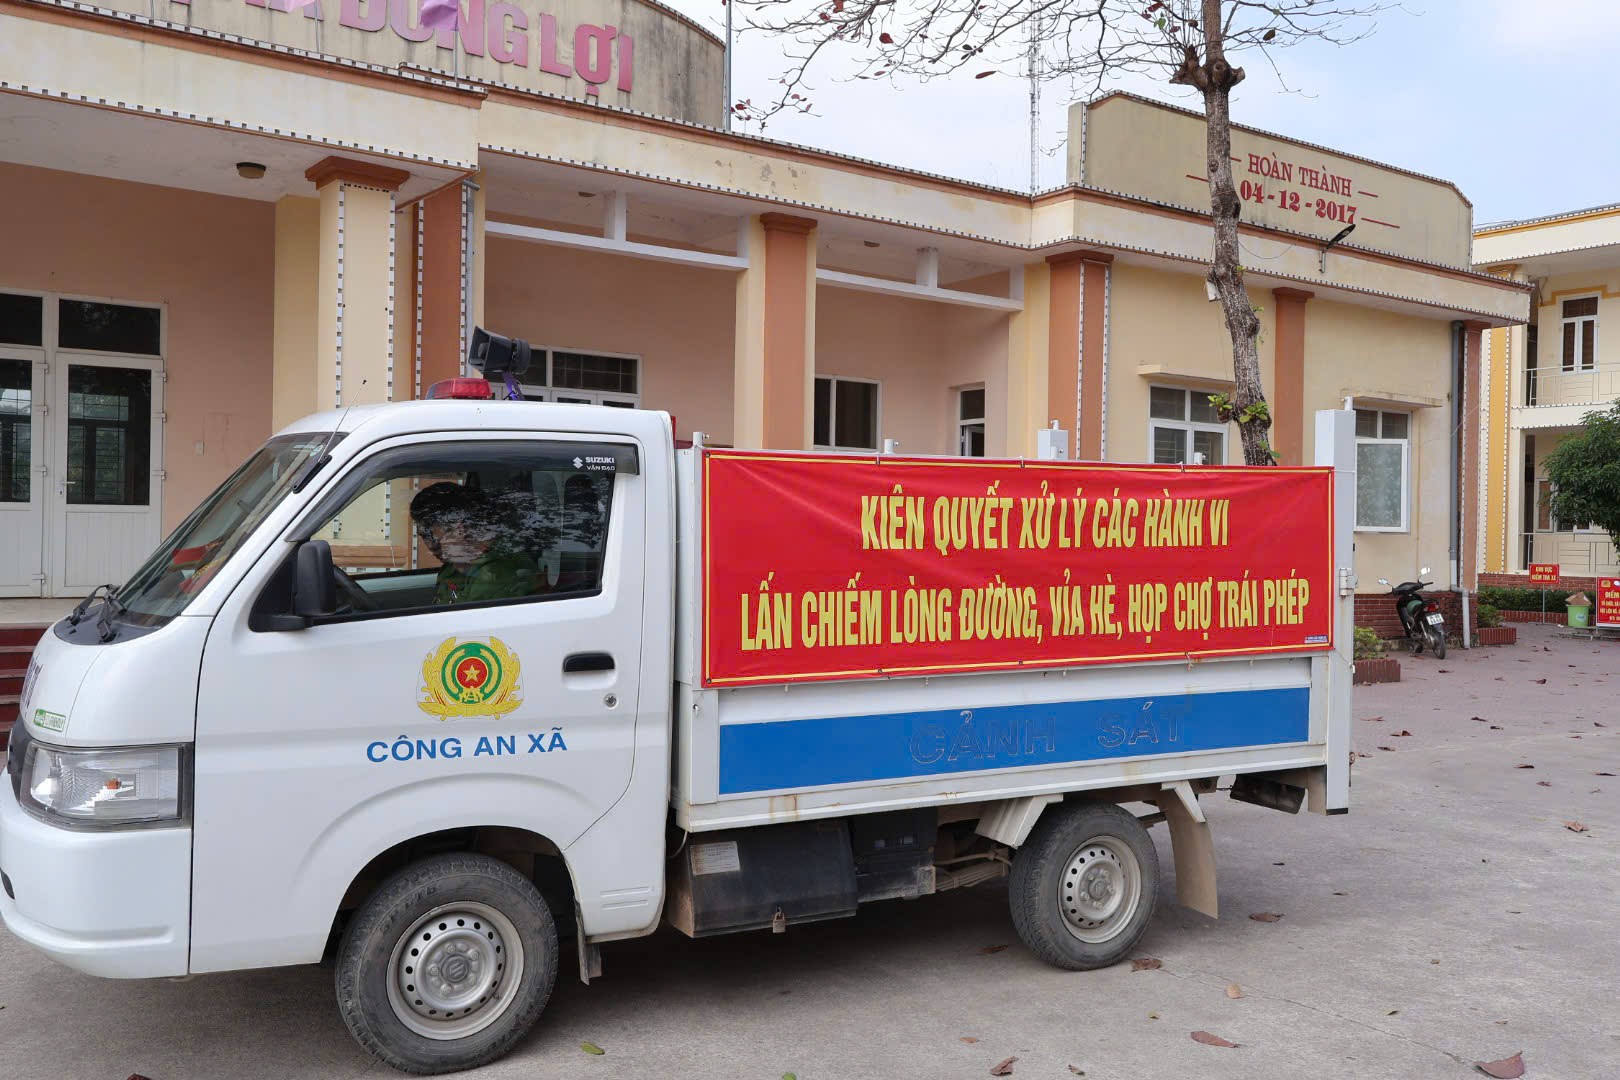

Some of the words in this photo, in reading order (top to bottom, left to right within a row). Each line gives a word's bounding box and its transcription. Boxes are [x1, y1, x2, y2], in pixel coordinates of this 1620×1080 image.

[539, 12, 633, 97] LỢI
[1247, 152, 1293, 182] HOÀN
[1298, 165, 1352, 197] THÀNH
[861, 484, 924, 549] KIÊN
[933, 480, 1013, 555] QUYẾT
[1019, 480, 1056, 549] XỬ
[1058, 488, 1087, 548] LÝ
[1093, 488, 1138, 547] CÁC
[1144, 488, 1204, 547] HÀNH
[1209, 499, 1230, 546] VI
[741, 572, 792, 651] LẤN
[801, 572, 882, 648] CHIẾM
[891, 576, 952, 644] LÒNG
[959, 575, 1043, 644] ĐƯỜNG,
[1050, 568, 1085, 637] VỈA
[1090, 573, 1123, 639] HÈ,
[1128, 583, 1168, 643] HỌP
[1174, 577, 1213, 640] CHỢ
[1218, 570, 1258, 629] TRÁI
[1263, 568, 1310, 625] PHÉP
[366, 735, 462, 763] CÔNG
[474, 735, 516, 757] AN
[527, 727, 568, 754] XÃ
[909, 710, 1056, 764] CẢNH
[1097, 701, 1184, 748] SÁT
